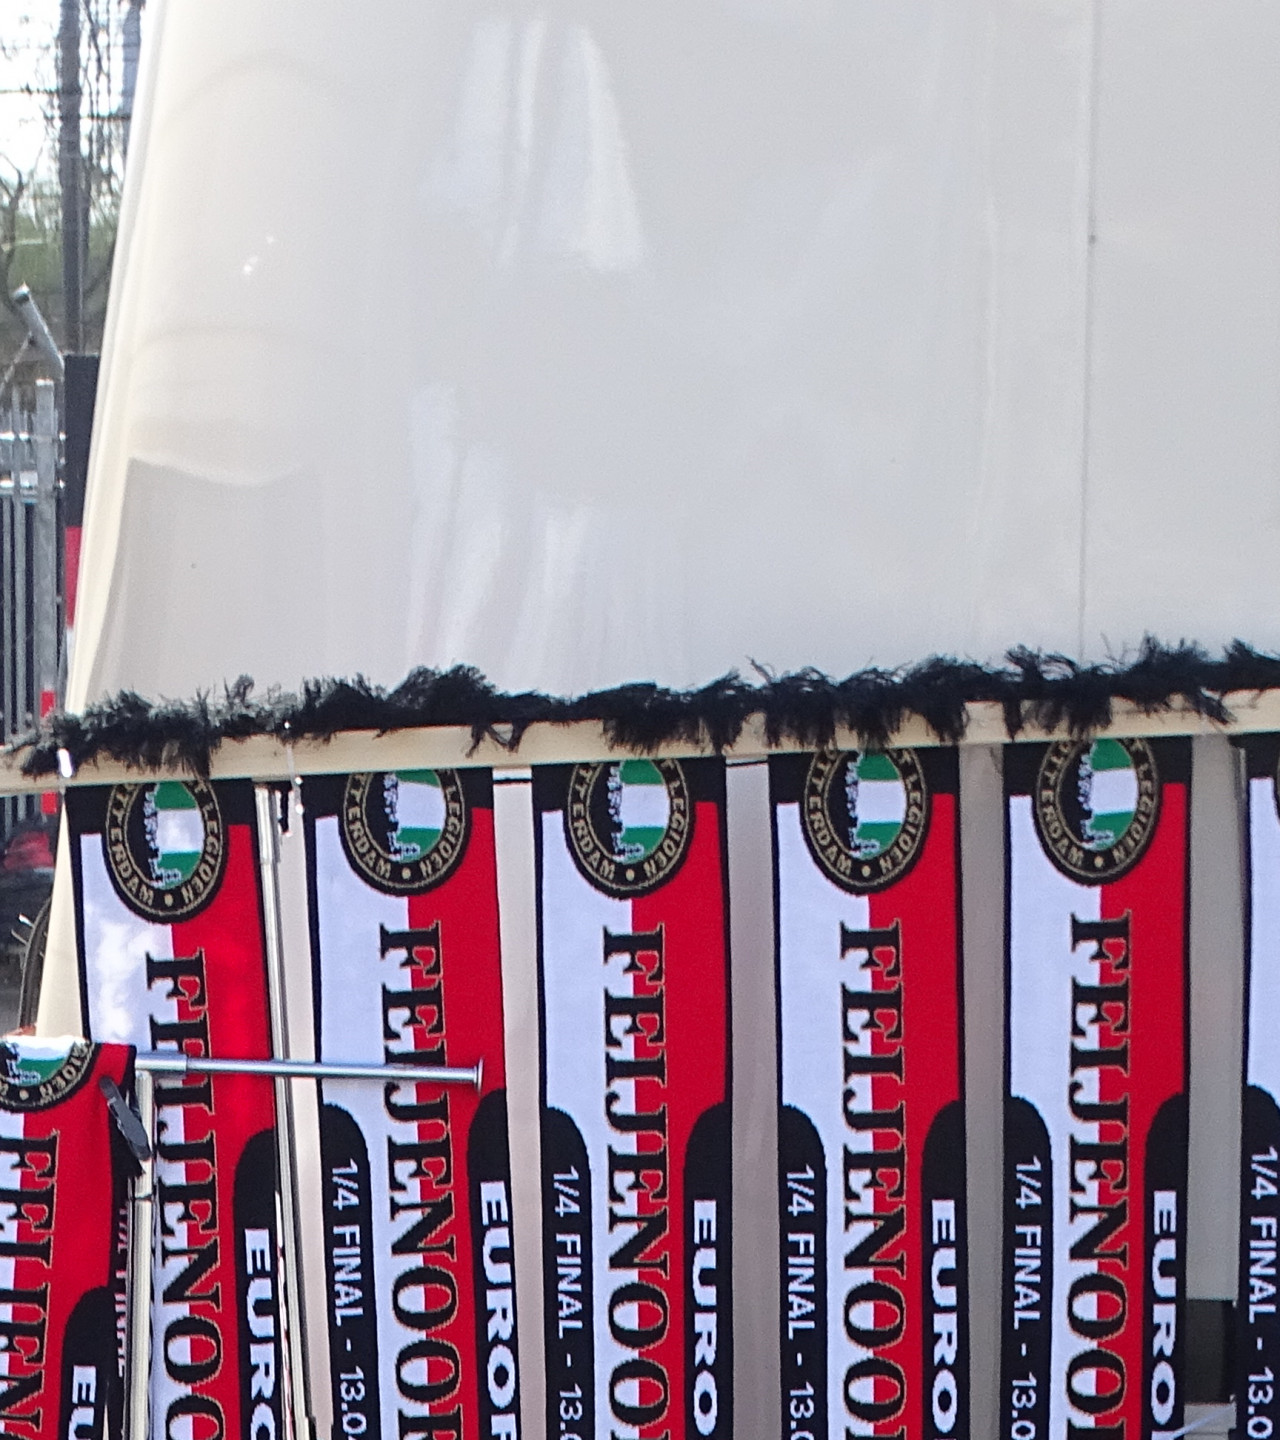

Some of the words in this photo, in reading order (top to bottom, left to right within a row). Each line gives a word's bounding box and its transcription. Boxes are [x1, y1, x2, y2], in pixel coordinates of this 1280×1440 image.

[331, 1158, 359, 1210] 1/4
[552, 1166, 580, 1217] 1/4
[786, 1164, 814, 1218] 1/4
[1015, 1156, 1039, 1209] 1/4
[1250, 1147, 1277, 1200] 1/4
[333, 1224, 363, 1327] FINAL
[555, 1232, 582, 1339] FINAL
[787, 1232, 815, 1339] FINAL
[1013, 1224, 1042, 1330] FINAL
[1249, 1216, 1277, 1323] FINAL
